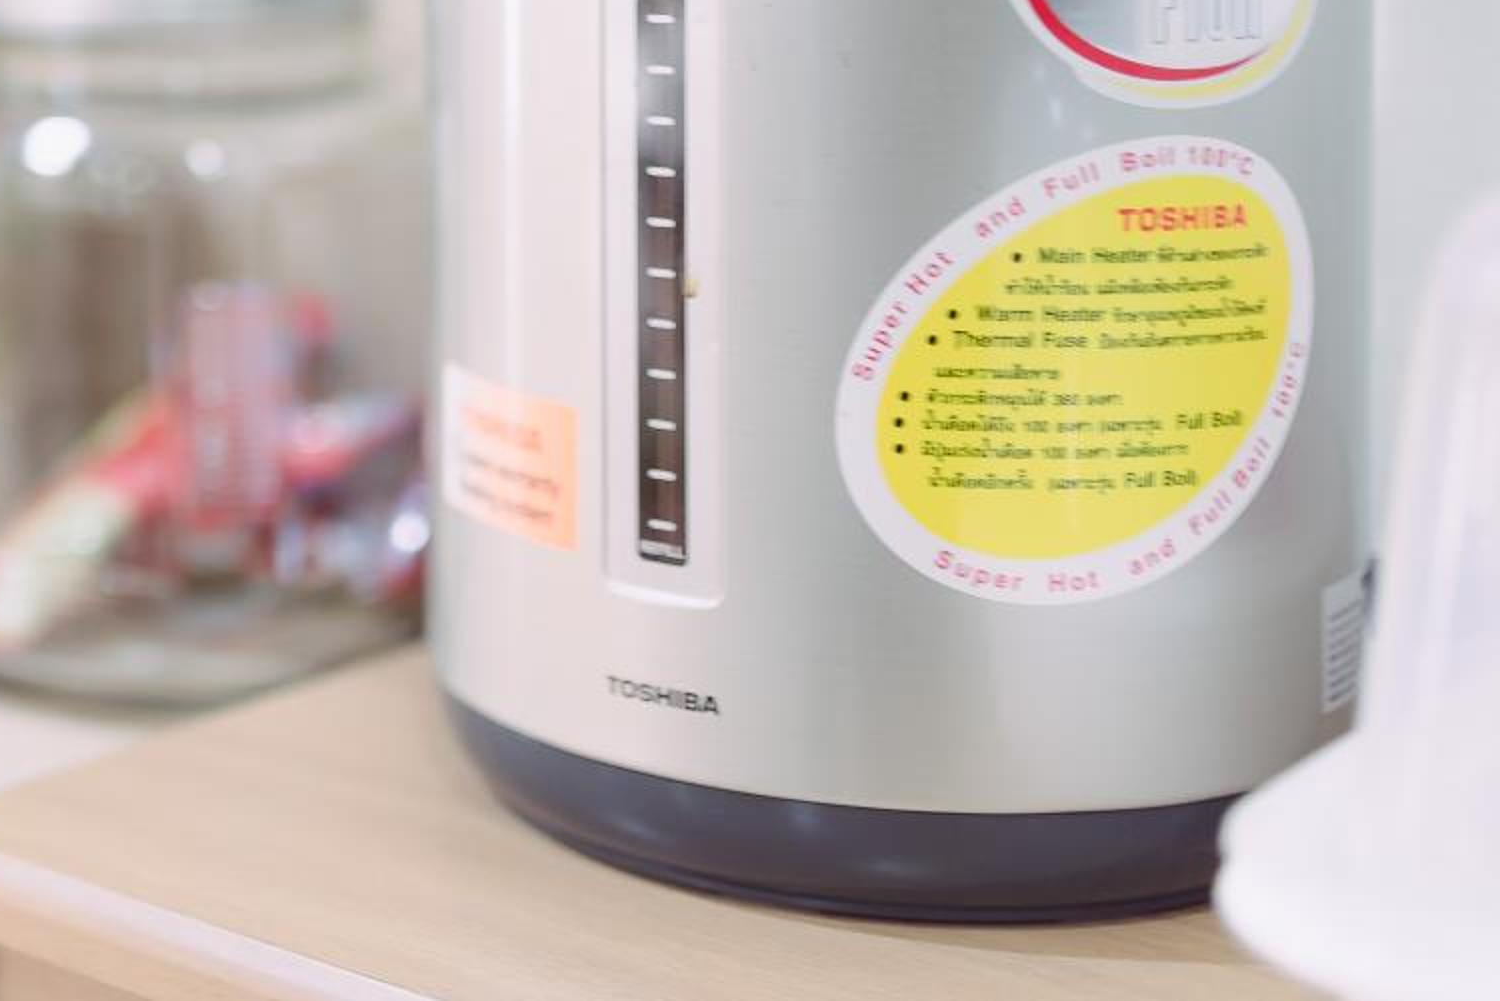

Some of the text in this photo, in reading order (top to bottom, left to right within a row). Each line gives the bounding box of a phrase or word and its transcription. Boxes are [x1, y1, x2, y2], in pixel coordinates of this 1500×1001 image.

[1117, 204, 1249, 233] TOSHIBA
[1091, 248, 1155, 264] Heater
[852, 302, 908, 381] Super
[905, 250, 956, 296] Hot
[974, 198, 1027, 239] and
[1042, 162, 1101, 199] Full
[976, 306, 1034, 322] Warm
[1041, 306, 1107, 322] Heater
[953, 330, 1034, 349] Thermal
[1042, 331, 1089, 349] Fuse
[935, 550, 1023, 589] Super
[1047, 571, 1102, 593] Hot
[1129, 538, 1178, 577] and
[1188, 490, 1233, 536] Full
[605, 674, 721, 715] TOSHIBA
